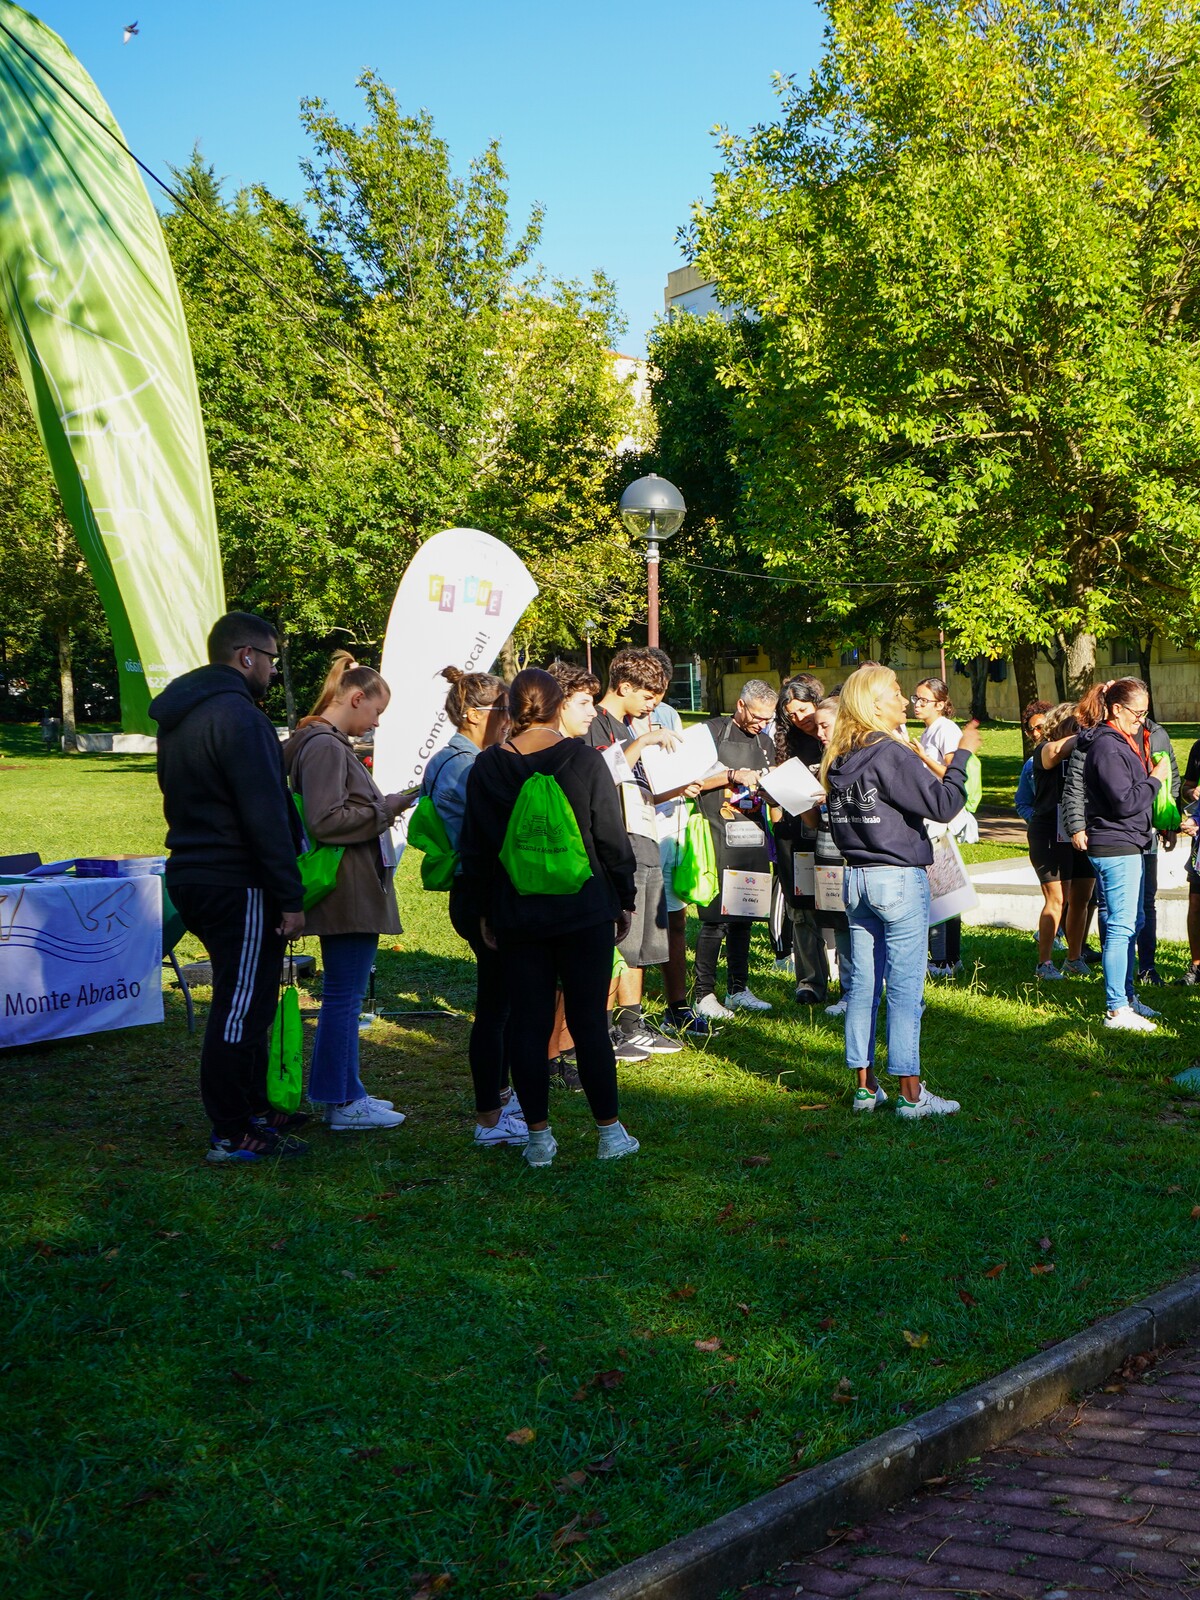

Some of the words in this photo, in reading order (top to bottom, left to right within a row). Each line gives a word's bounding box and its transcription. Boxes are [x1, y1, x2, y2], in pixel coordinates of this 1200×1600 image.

[464, 631, 491, 671] ocal!
[5, 990, 71, 1017] Monte
[76, 978, 141, 1008] Abraão
